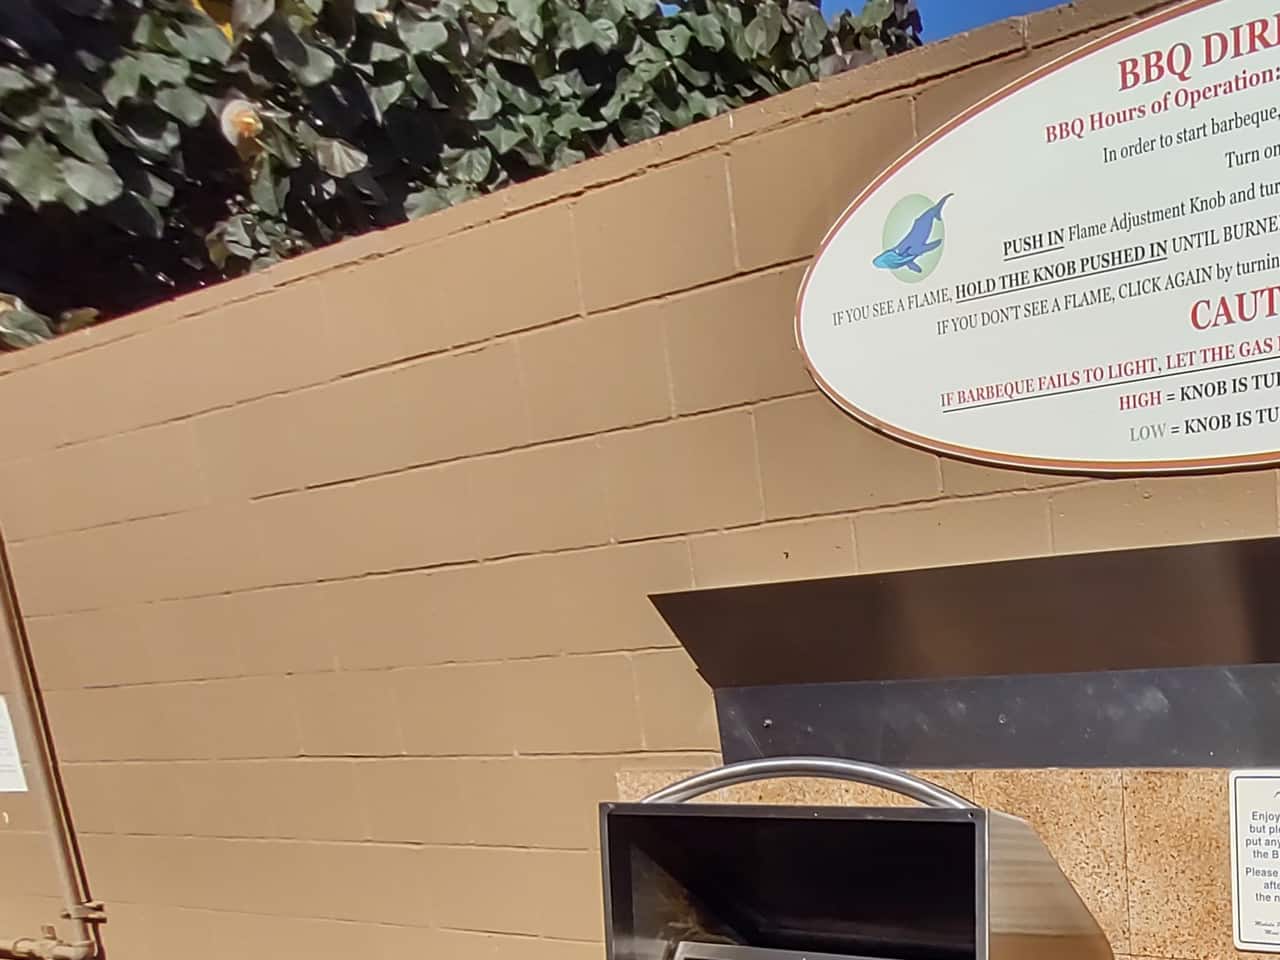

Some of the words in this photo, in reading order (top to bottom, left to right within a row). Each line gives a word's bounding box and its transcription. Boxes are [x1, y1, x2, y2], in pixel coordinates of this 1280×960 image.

[1118, 43, 1193, 91] BBQ
[1046, 118, 1084, 143] BBQ
[1090, 105, 1146, 131] Hours
[1150, 91, 1171, 114] of
[1173, 67, 1280, 109] Operation:
[1104, 147, 1116, 163] In
[1121, 137, 1156, 158] order
[1160, 134, 1173, 148] to
[1176, 123, 1206, 144] start
[1211, 107, 1280, 135] barbeque,
[1225, 150, 1259, 168] Turn
[1264, 144, 1280, 159] on
[1004, 233, 1043, 256] PUSH
[1048, 228, 1064, 246] IN
[1069, 223, 1106, 241] Flame
[1110, 202, 1185, 232] Adjustment
[1190, 191, 1225, 214] Knob
[1230, 182, 1255, 205] and
[833, 311, 845, 326] IF
[846, 305, 869, 323] YOU
[873, 300, 894, 317] SEE
[897, 299, 905, 312] A
[908, 288, 953, 309] FLAME,
[956, 278, 996, 299] HOLD
[998, 270, 1029, 289] THE
[1033, 261, 1076, 283] KNOB
[1080, 246, 1145, 273] PUSHED
[1150, 240, 1167, 258] IN
[1172, 230, 1219, 253] UNTIL
[937, 320, 950, 335] IF
[952, 314, 978, 332] YOU
[1023, 299, 1049, 318] SEE
[1051, 298, 1061, 312] A
[1064, 287, 1115, 310] FLAME,
[1118, 277, 1161, 299] CLICK
[1164, 266, 1212, 290] AGAIN
[1216, 263, 1232, 282] by
[941, 392, 955, 407] IF
[957, 379, 1034, 404] BARBEQUE
[1038, 371, 1080, 391] FAILS
[1083, 367, 1103, 383] TO
[1108, 357, 1162, 379] LIGHT,
[1166, 351, 1196, 369] LET
[1200, 344, 1235, 363] THE
[1239, 338, 1273, 357] GAS
[1120, 391, 1161, 410] HIGH
[1181, 381, 1227, 401] KNOB
[1232, 377, 1248, 393] IS
[1131, 424, 1166, 441] LOW
[1185, 414, 1231, 434] KNOB
[1236, 411, 1252, 427] IS
[1250, 824, 1266, 833] but
[1252, 812, 1280, 823] Enjoy
[1245, 838, 1261, 848] put
[1253, 850, 1268, 859] the
[1245, 868, 1278, 878] Please
[1256, 893, 1271, 902] the
